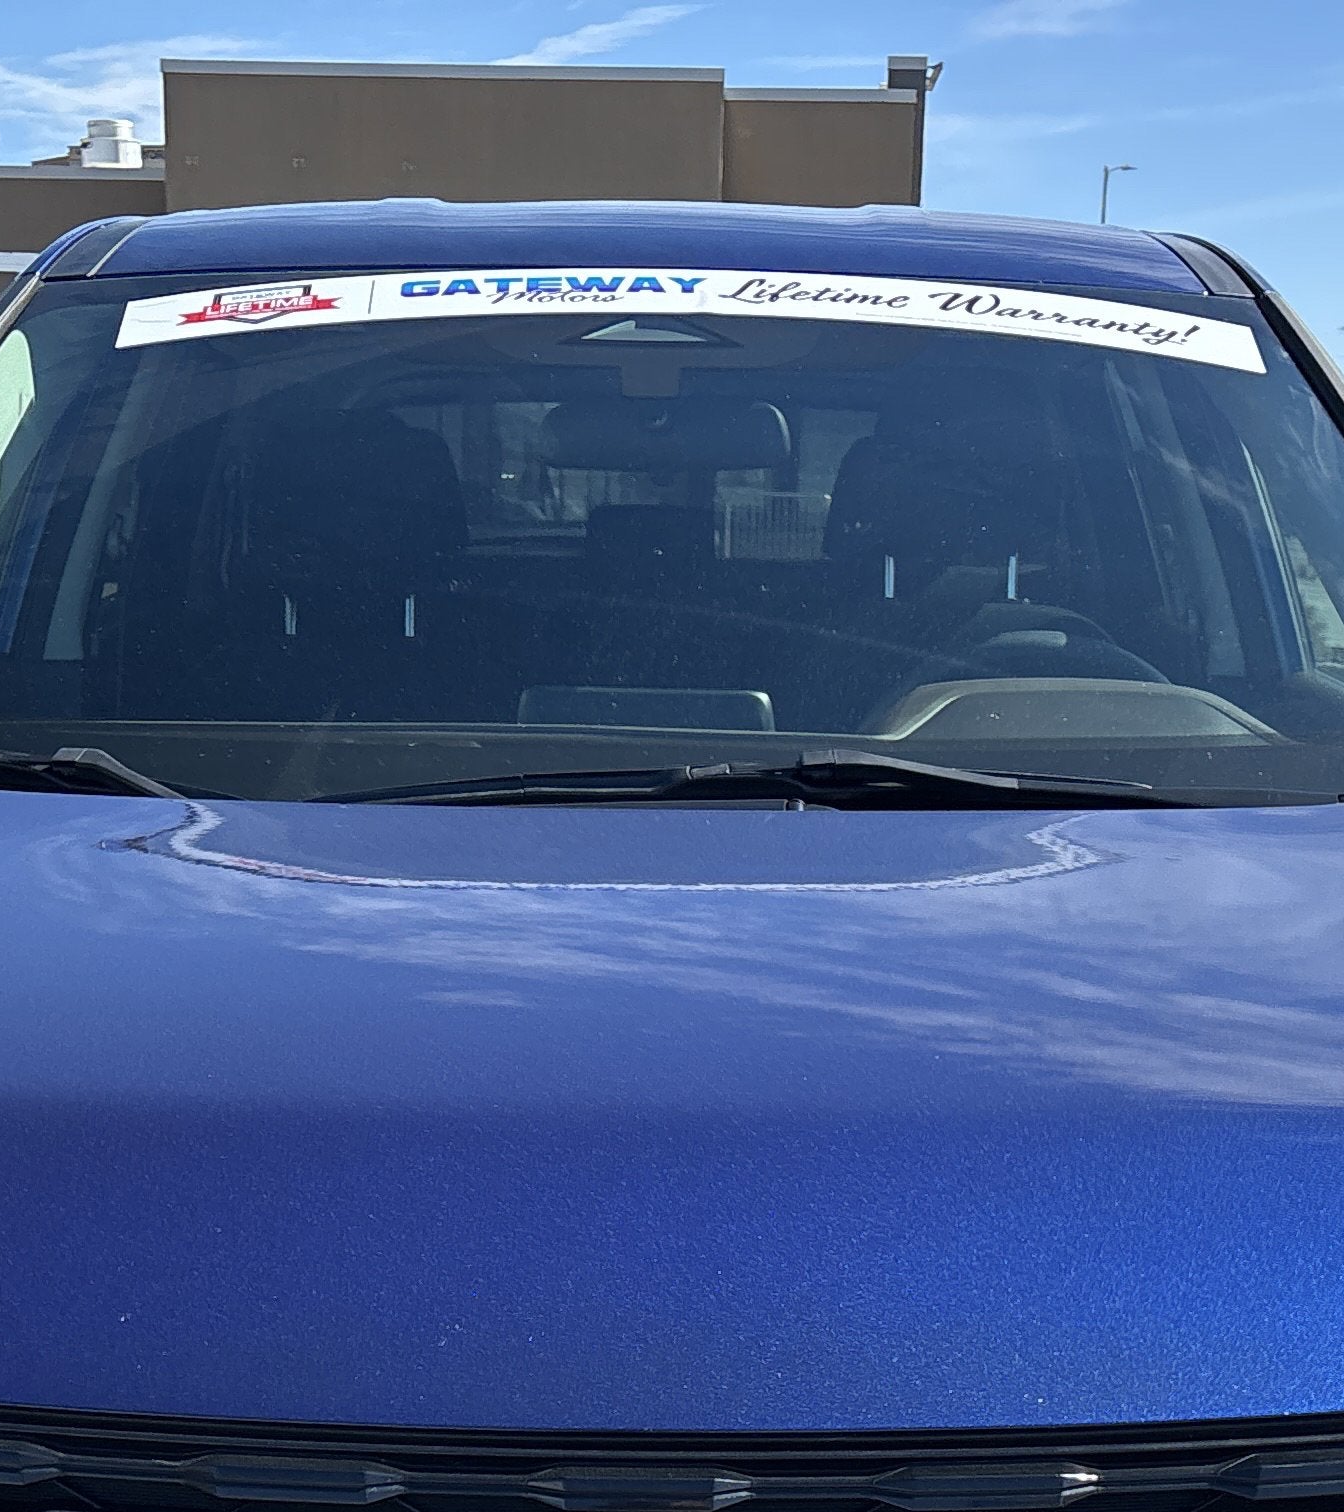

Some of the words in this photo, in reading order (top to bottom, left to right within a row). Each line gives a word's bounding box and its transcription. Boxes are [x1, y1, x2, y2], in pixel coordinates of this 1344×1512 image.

[400, 276, 709, 298] GATEWAY
[486, 288, 625, 304] Motors
[206, 295, 314, 316] LIFETIME
[719, 277, 909, 310] Lifetime
[928, 291, 1201, 346] Warranty!
